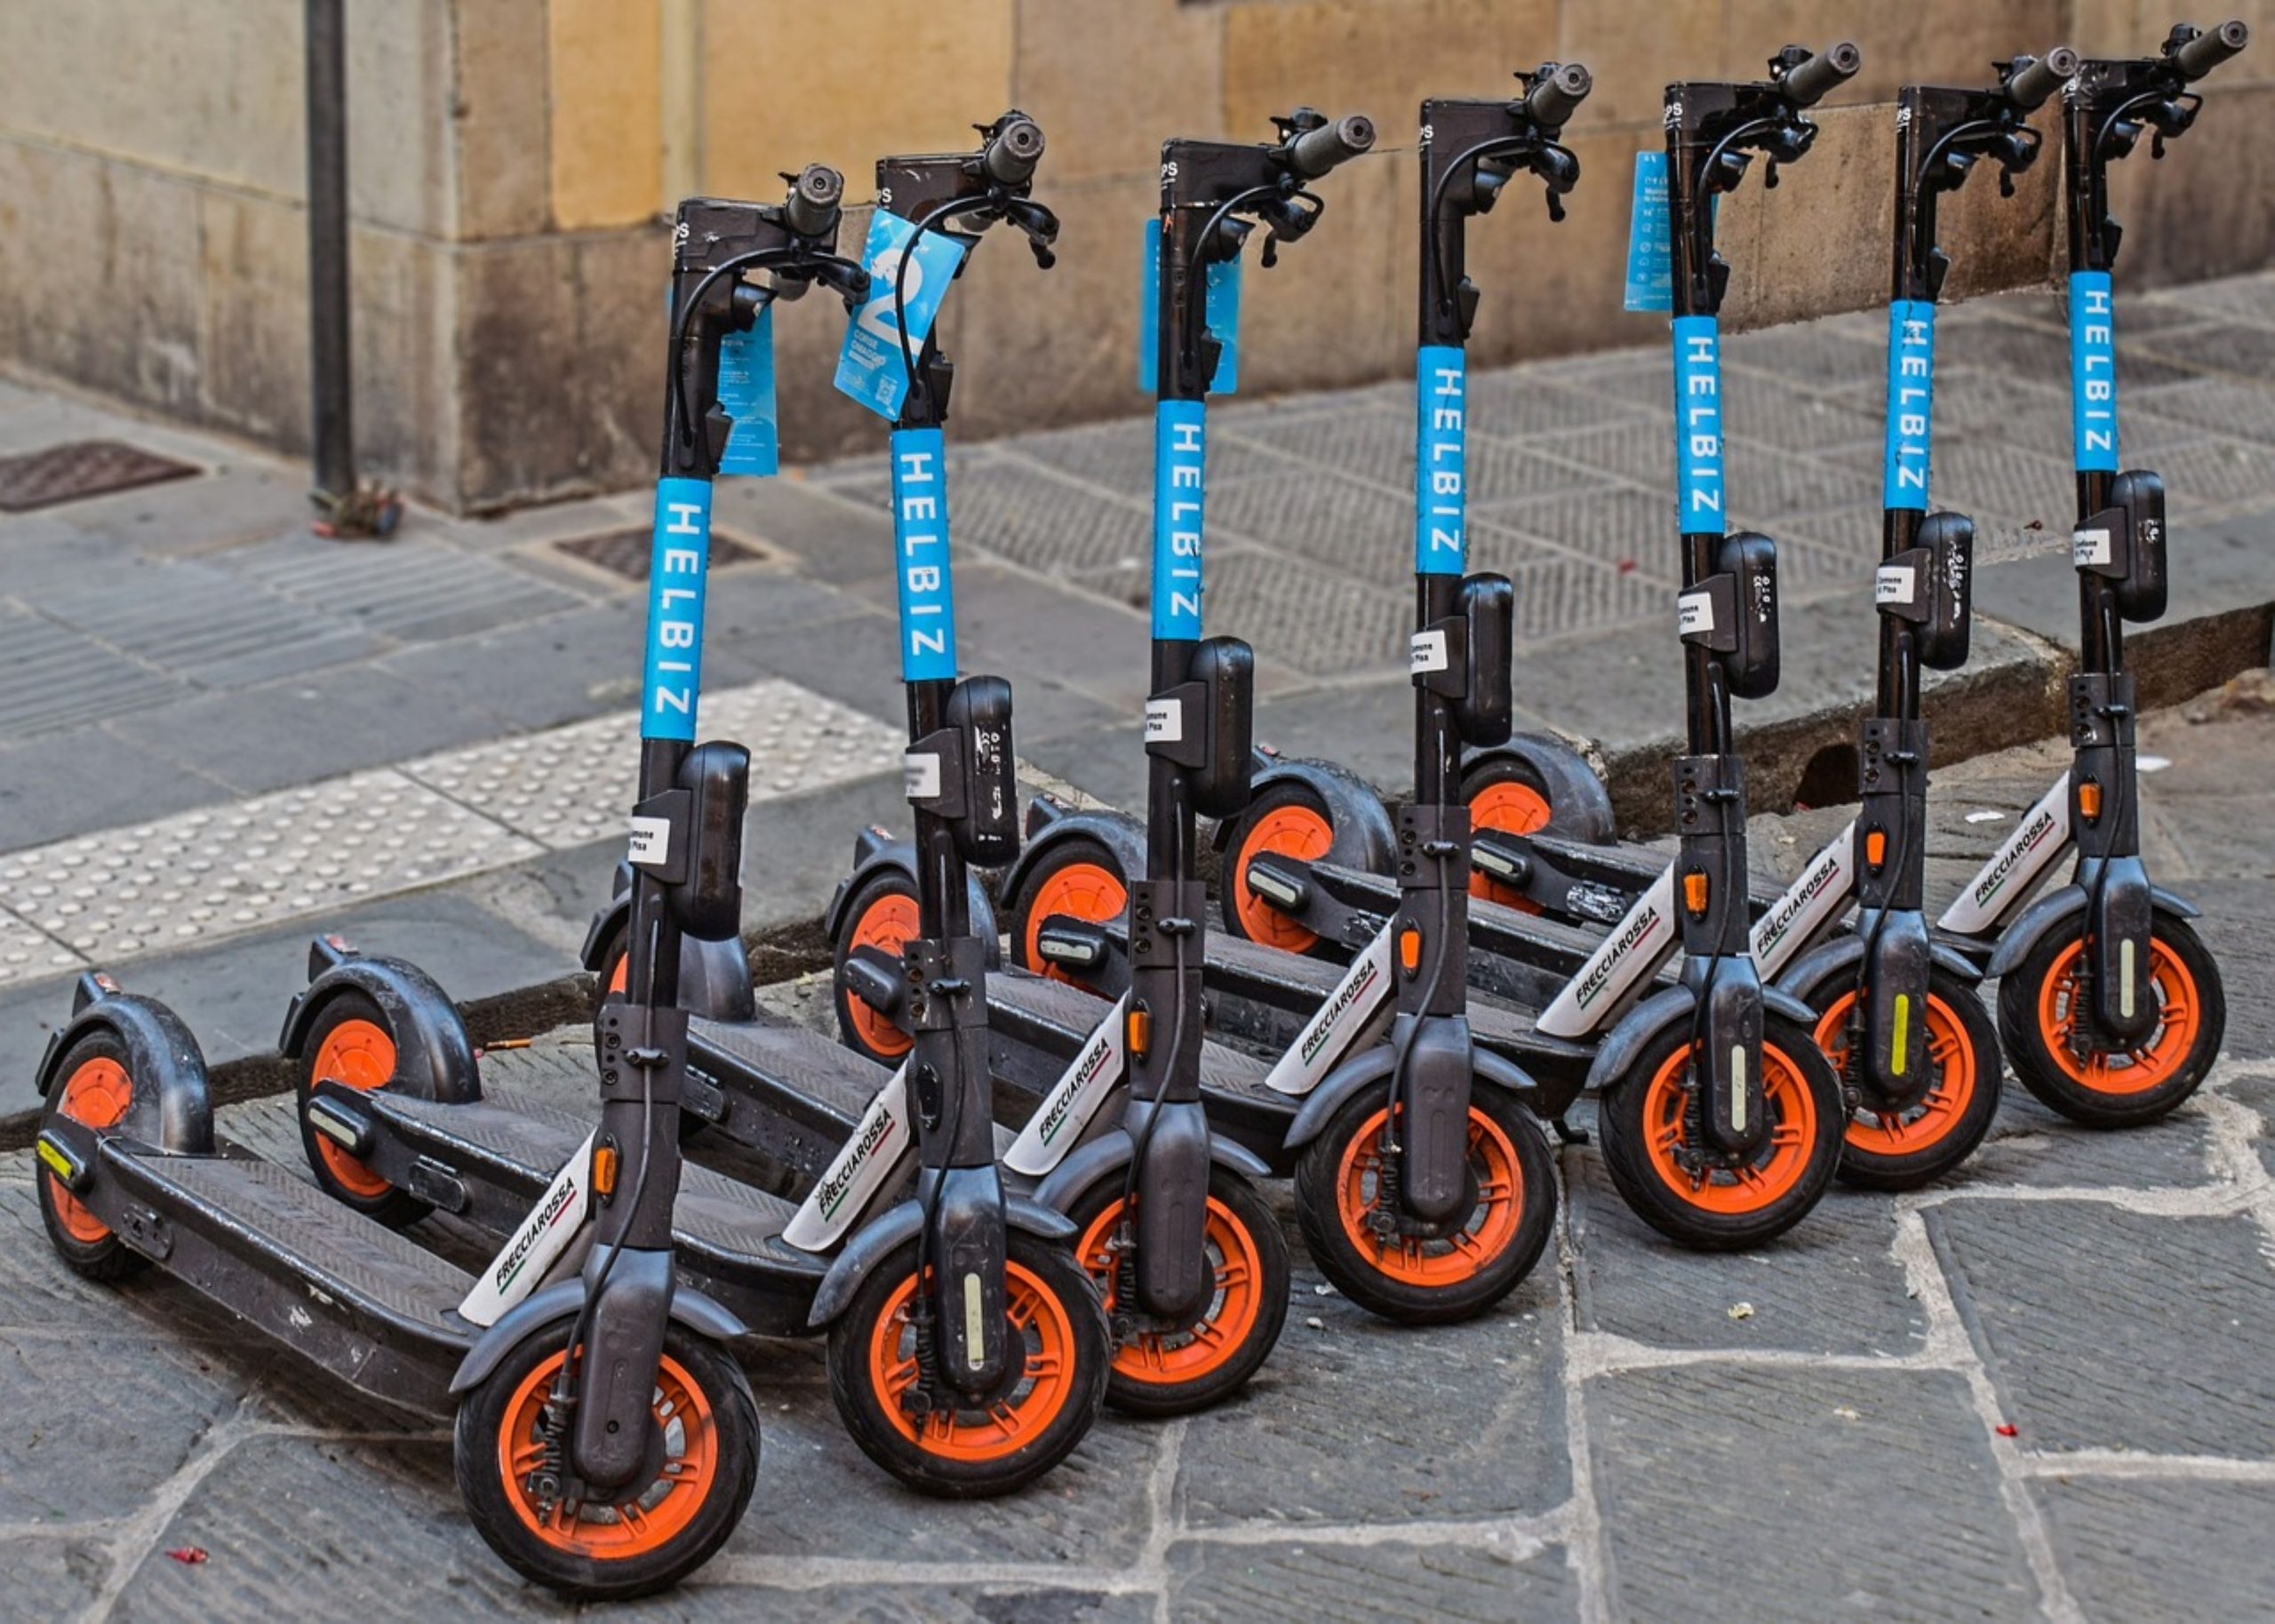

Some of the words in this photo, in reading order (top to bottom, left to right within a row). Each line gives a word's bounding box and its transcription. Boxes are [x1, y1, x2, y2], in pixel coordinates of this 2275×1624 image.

[1688, 337, 1719, 512] HELBIZ
[1898, 320, 1928, 489] HELBIZ
[2086, 291, 2111, 450] HELBIZ
[1170, 423, 1201, 617] HELBIZ
[1432, 368, 1462, 553] HELBIZ
[655, 503, 701, 714] HELBIZ
[900, 453, 945, 656] HELBIZ
[1757, 857, 1837, 952] FRECCIAROSSA
[1975, 812, 2053, 902] FRECCIAROSSA
[1301, 959, 1376, 1060] FRECCIAROSSA
[1576, 906, 1656, 1003] FRECCIAROSSA
[1039, 1038, 1109, 1140] FRECCIAROSSA
[819, 1108, 892, 1214] FRECCIAROSSA
[496, 1176, 574, 1287] FRECCIAROSSA
